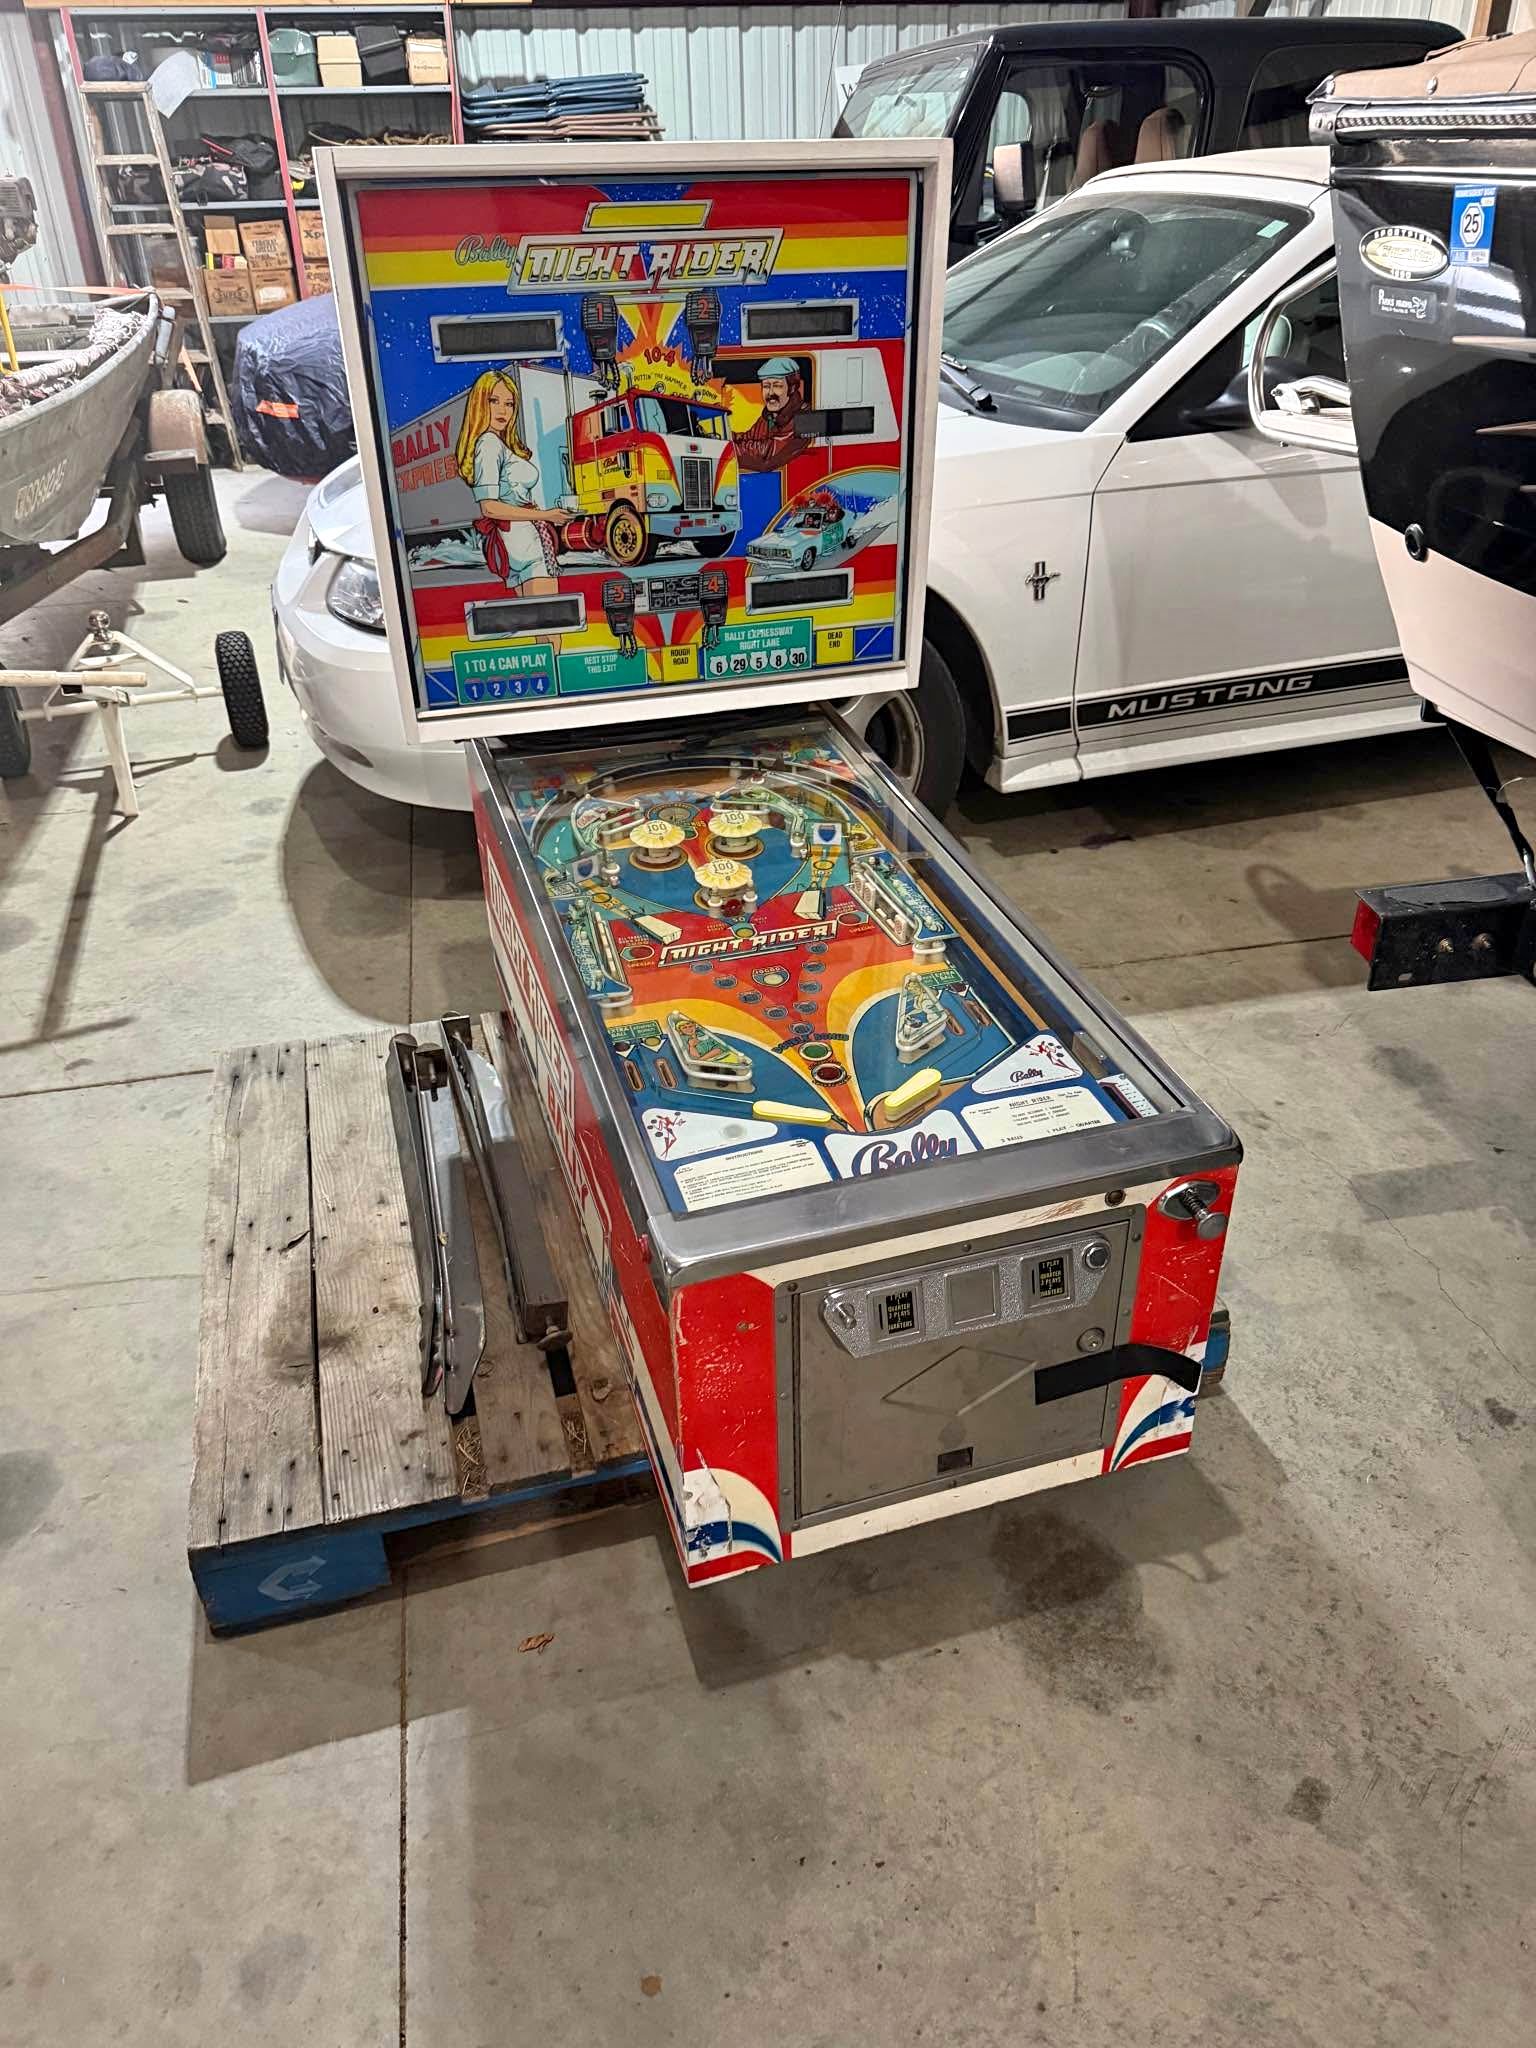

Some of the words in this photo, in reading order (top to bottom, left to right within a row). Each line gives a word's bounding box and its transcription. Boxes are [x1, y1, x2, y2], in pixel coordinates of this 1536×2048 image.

[1464, 214, 1480, 233] 25
[455, 233, 518, 268] Bally
[528, 244, 641, 283] NIGHT
[647, 241, 768, 281] RIDER
[596, 302, 604, 321] 1
[697, 299, 710, 319] 2
[643, 346, 676, 367] 10-4
[612, 585, 625, 602] 3
[707, 576, 720, 593] 4
[747, 625, 794, 639] EXPRESSWAY
[827, 631, 843, 640] DEAD
[762, 638, 780, 648] LANE
[829, 639, 841, 648] END
[463, 660, 471, 673] 1
[471, 659, 486, 672] TO
[489, 657, 497, 670] 4
[499, 655, 519, 670] CAN
[521, 653, 547, 668] PLAY
[601, 654, 618, 664] STOP
[716, 661, 723, 673] 6
[733, 658, 746, 671] 29
[755, 657, 763, 669] 5
[775, 655, 782, 667] 8
[792, 652, 804, 664] 30
[587, 664, 601, 674] THIS
[602, 663, 617, 673] EXIT
[471, 685, 478, 698] 1
[493, 683, 501, 696] 2
[514, 681, 522, 694] 3
[536, 678, 544, 692] 4
[1107, 674, 1313, 719] MUSTANG
[725, 811, 745, 821] 100
[647, 822, 667, 832] 100
[713, 861, 734, 873] 100
[671, 938, 743, 960] NIGHT
[750, 925, 829, 946] RIDER
[1010, 1068, 1044, 1083] Bally
[851, 1131, 958, 1177] Bally
